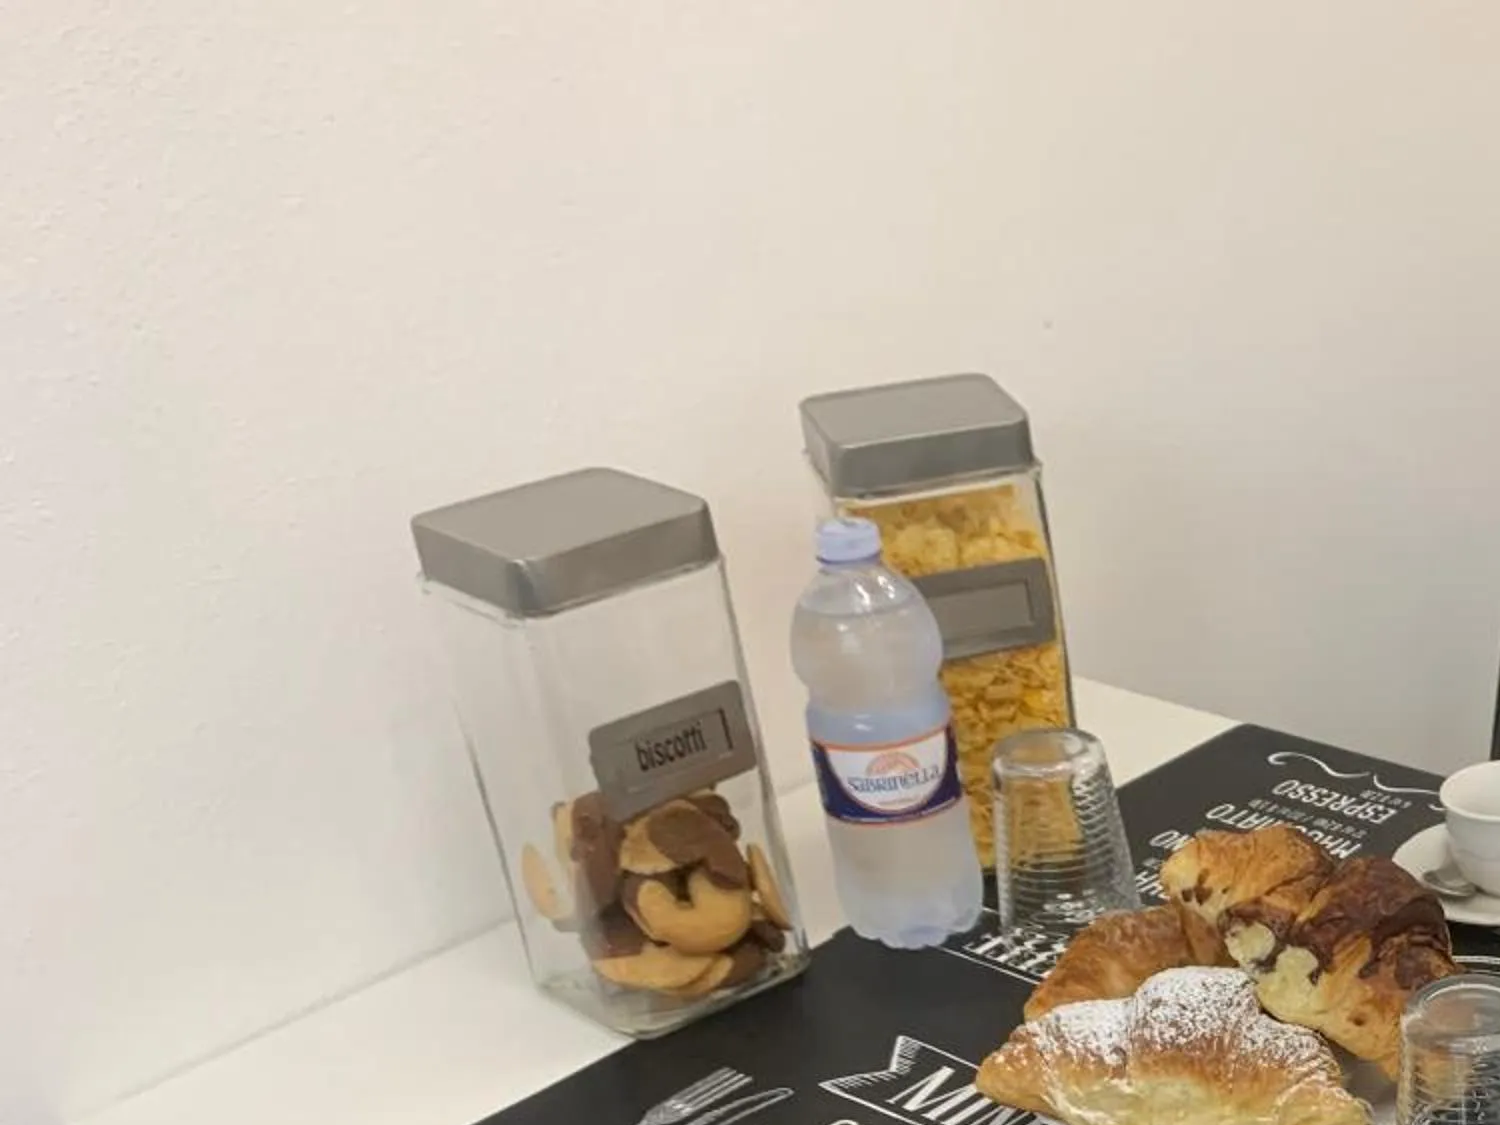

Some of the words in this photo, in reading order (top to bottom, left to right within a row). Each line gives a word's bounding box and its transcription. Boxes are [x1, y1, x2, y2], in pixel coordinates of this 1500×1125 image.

[635, 720, 707, 772] biscotti
[1271, 779, 1398, 824] ESPRESSO
[1205, 802, 1361, 860] MACIATO
